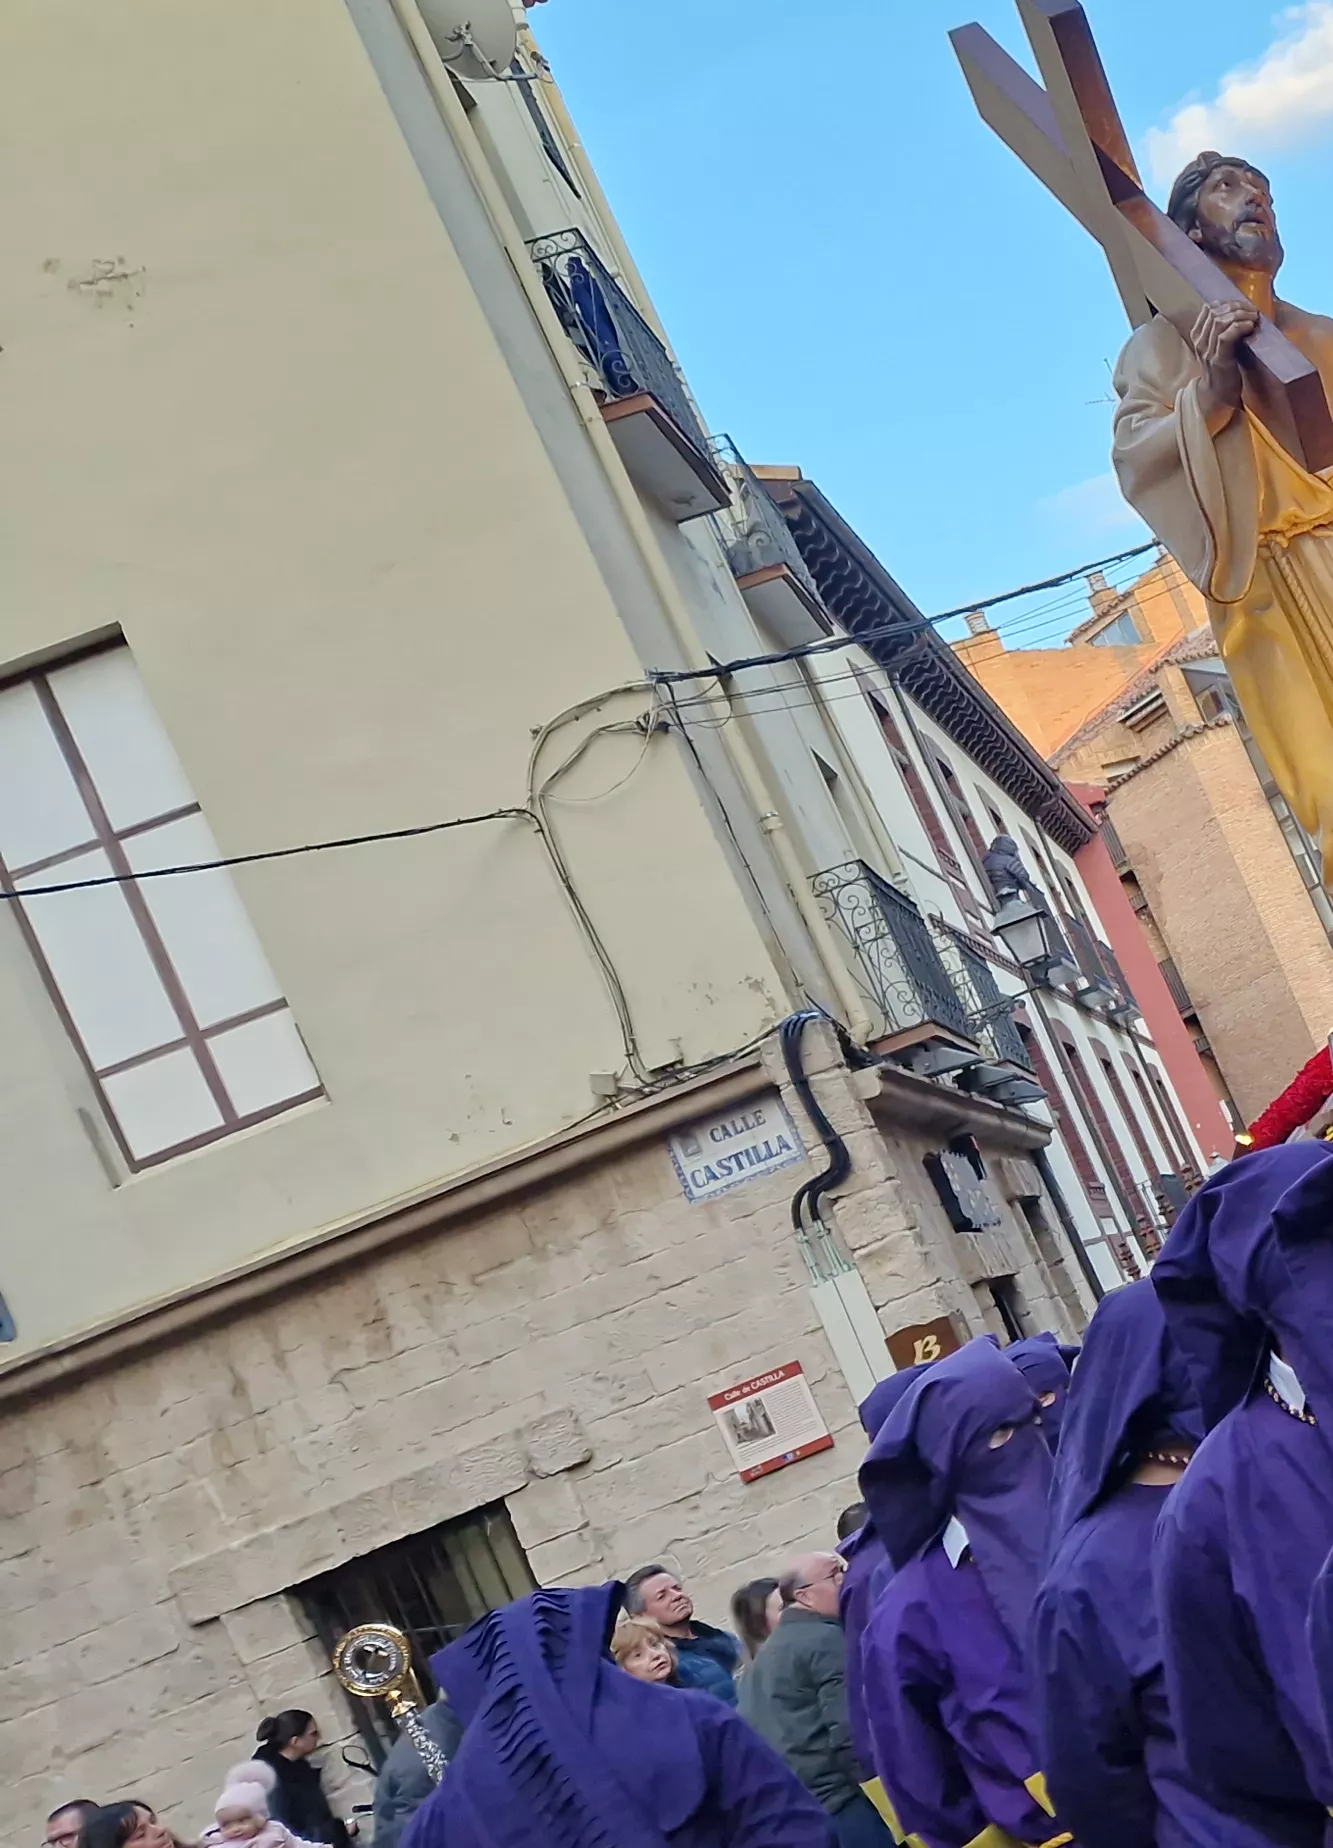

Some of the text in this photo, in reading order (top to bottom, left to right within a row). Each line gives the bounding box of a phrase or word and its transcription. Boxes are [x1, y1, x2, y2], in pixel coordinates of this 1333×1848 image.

[709, 1108, 766, 1143] CALLE
[689, 1134, 793, 1189] CASTILLA
[750, 1370, 785, 1390] CASTILLA
